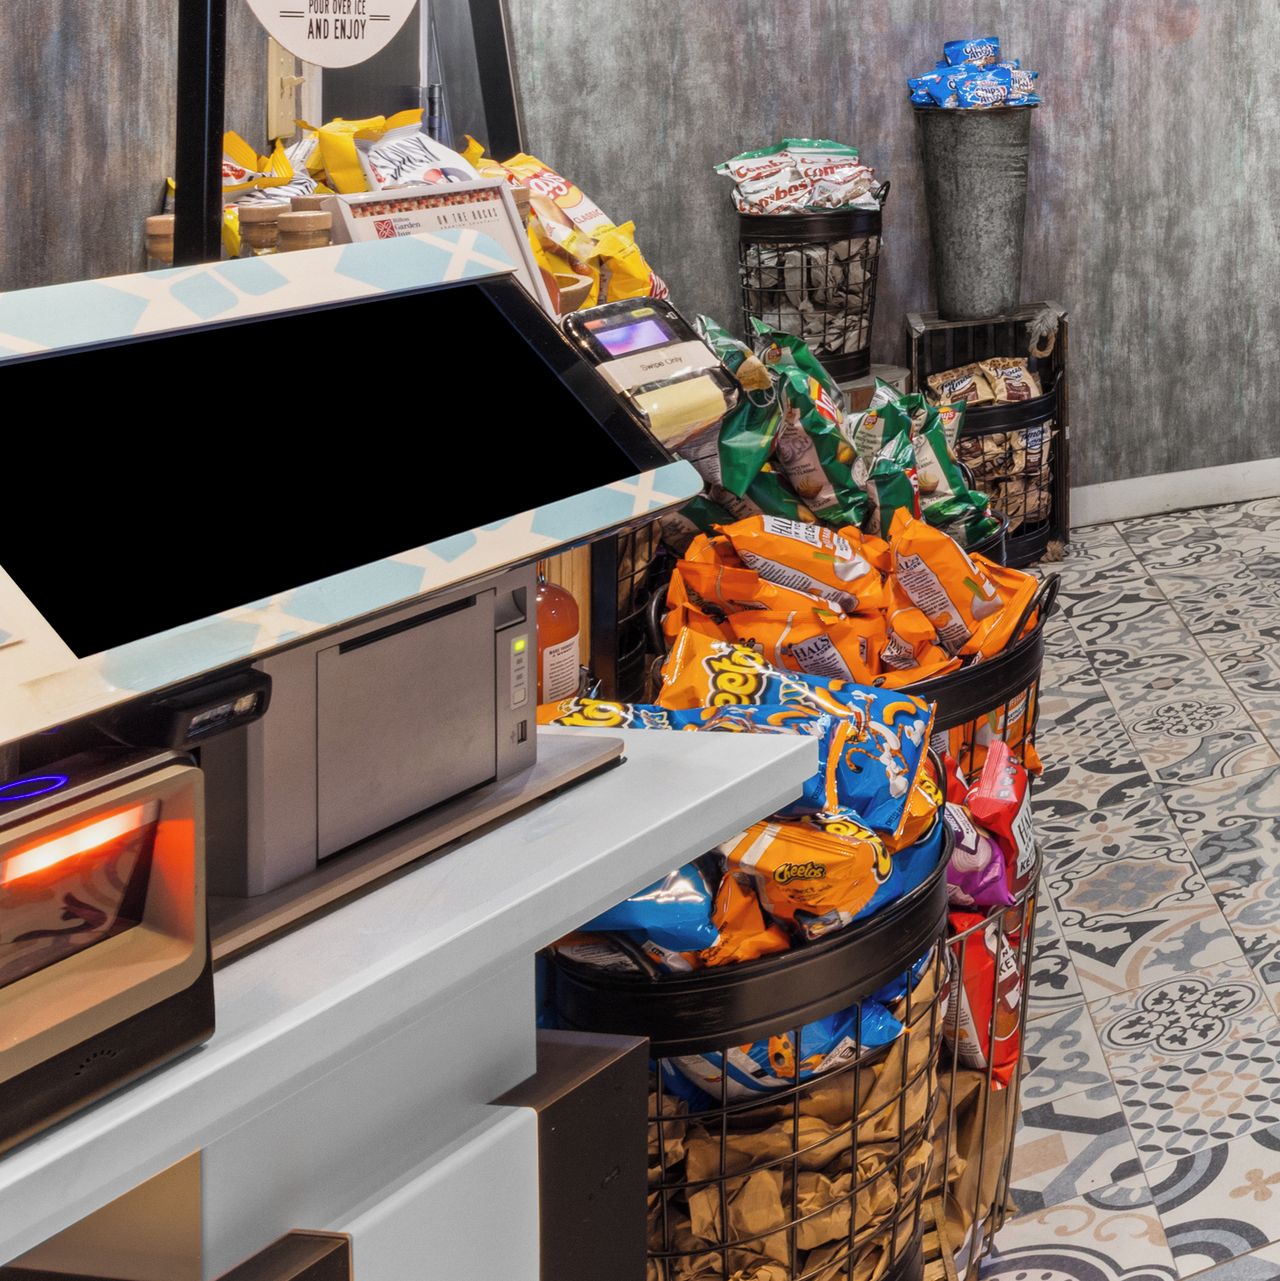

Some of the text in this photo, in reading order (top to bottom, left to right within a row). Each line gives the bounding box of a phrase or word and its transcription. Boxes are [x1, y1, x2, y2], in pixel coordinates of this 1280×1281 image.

[354, 0, 366, 15] ICE
[307, 19, 367, 40] AND ENJOY
[394, 219, 421, 230] Garden
[437, 214, 447, 226] ON
[451, 212, 468, 223] THE
[471, 208, 498, 220] ROCKS
[640, 355, 683, 372] Swipe Only
[773, 861, 827, 883] Cheetos
